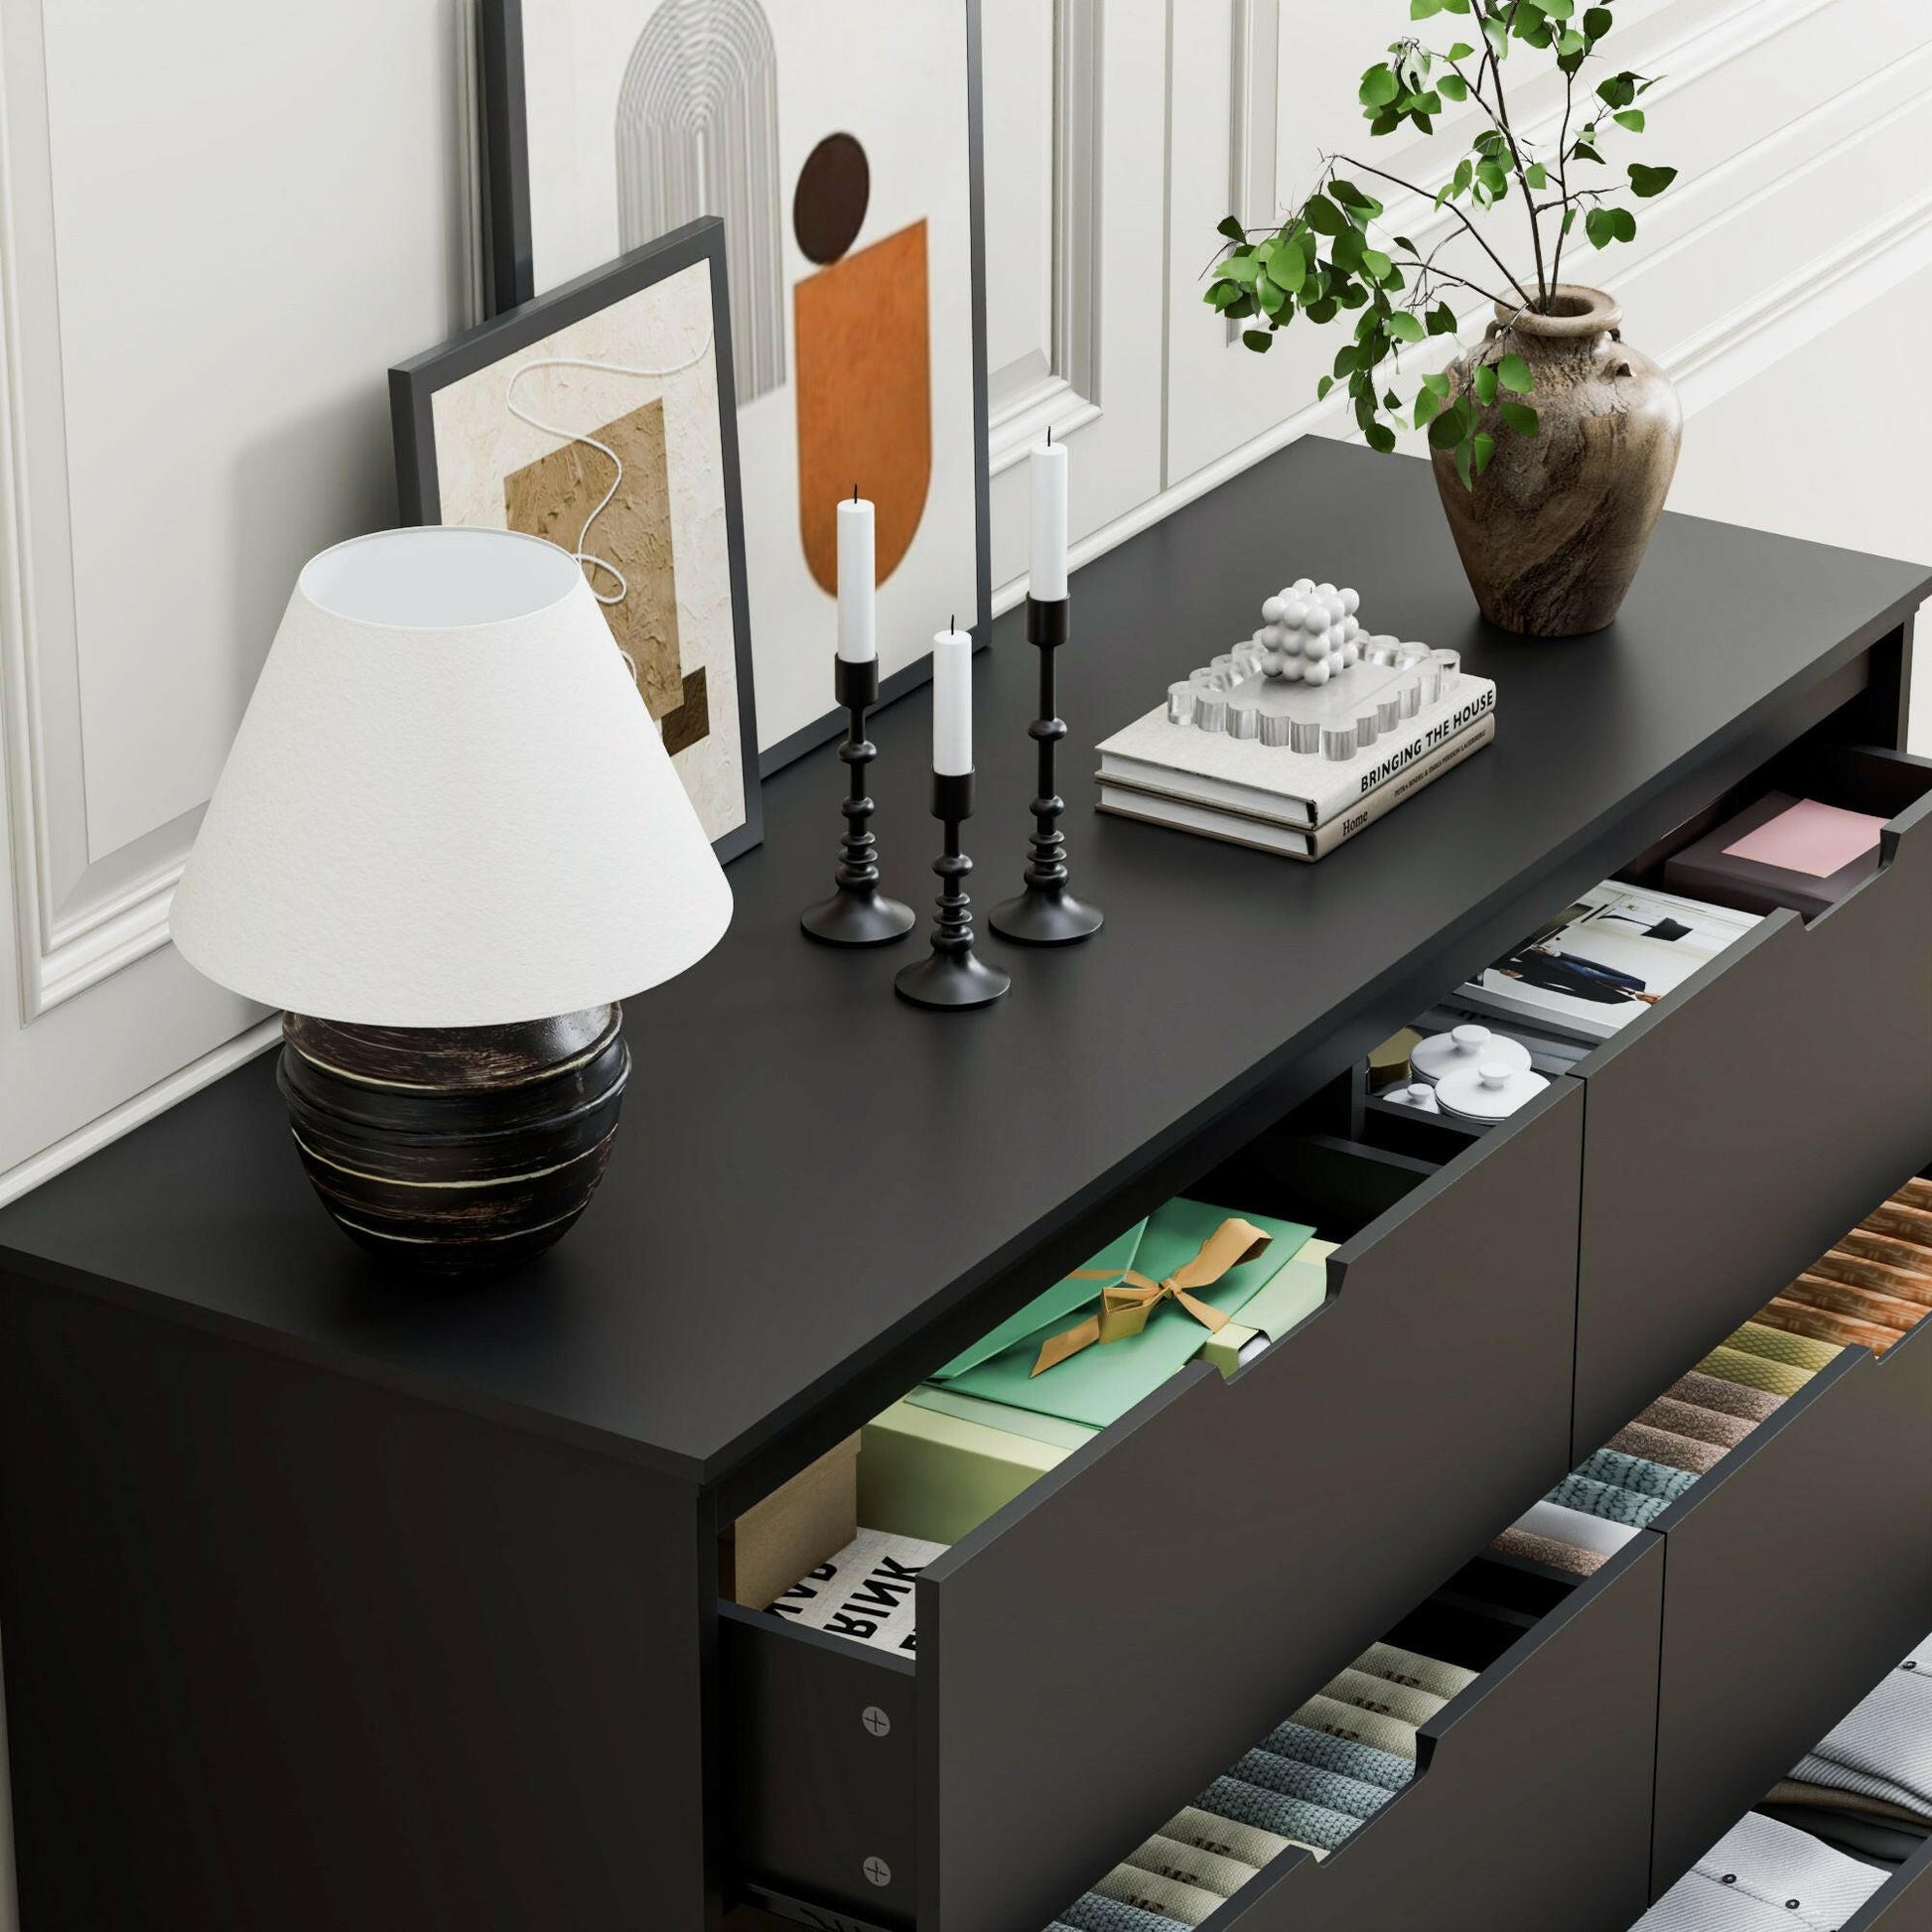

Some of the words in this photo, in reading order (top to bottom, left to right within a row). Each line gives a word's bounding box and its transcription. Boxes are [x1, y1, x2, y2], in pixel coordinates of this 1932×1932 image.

[1361, 739, 1422, 793] BRINGING
[1426, 720, 1449, 747] THE
[1453, 689, 1493, 729] HOUSE
[1342, 811, 1368, 836] Home
